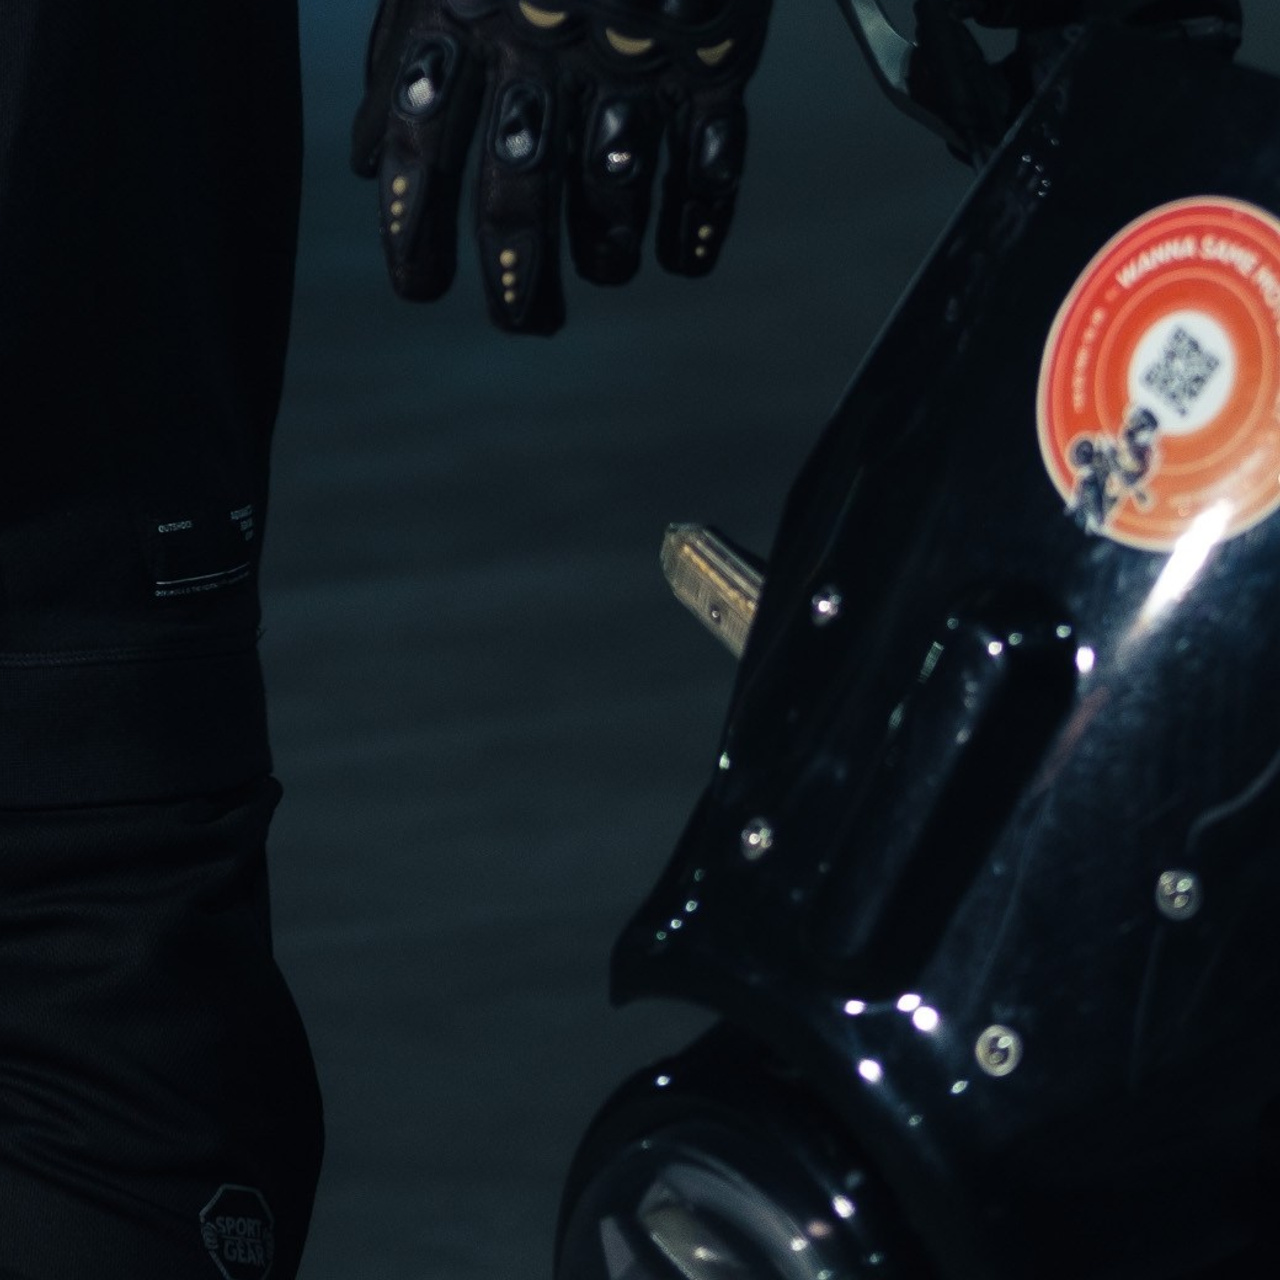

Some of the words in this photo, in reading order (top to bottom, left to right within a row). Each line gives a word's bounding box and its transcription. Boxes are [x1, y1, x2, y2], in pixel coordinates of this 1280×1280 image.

[1115, 236, 1196, 289] WANNA
[215, 1216, 262, 1237] SPORT
[223, 1239, 266, 1267] GEAR
